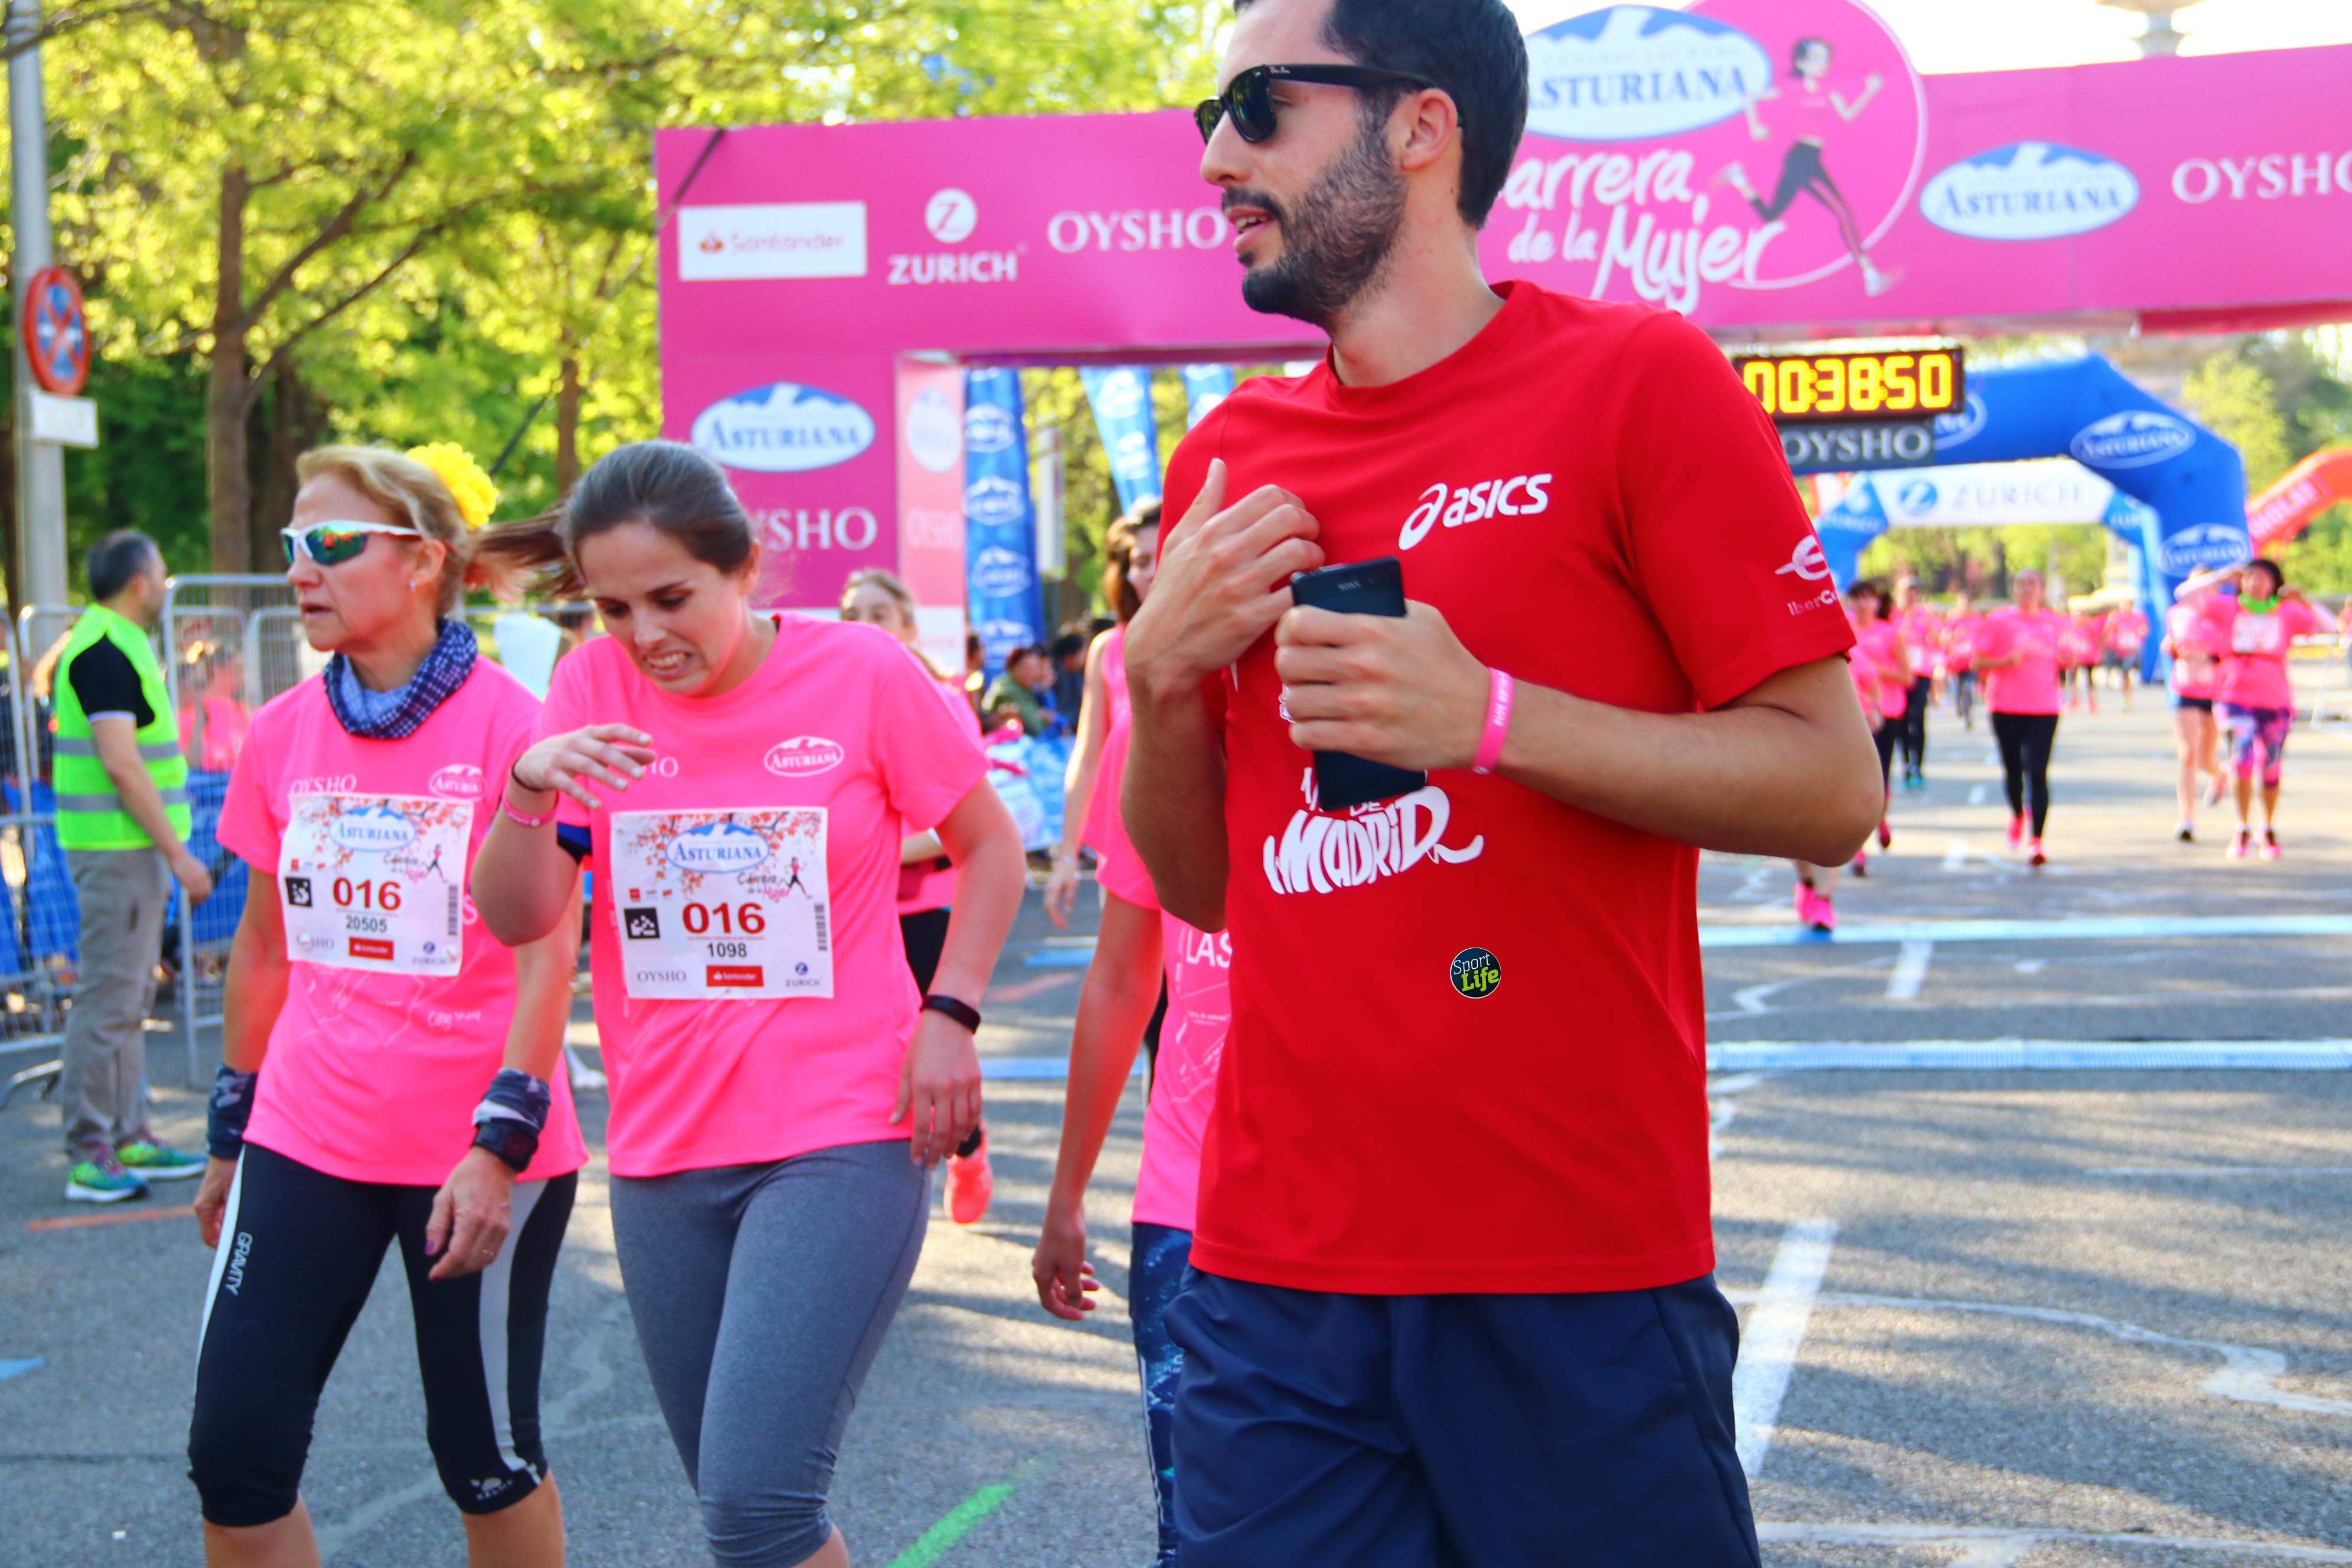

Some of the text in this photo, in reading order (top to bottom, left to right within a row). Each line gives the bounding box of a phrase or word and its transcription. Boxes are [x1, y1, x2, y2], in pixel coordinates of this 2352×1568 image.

[1528, 66, 1746, 110] STURIANA
[1503, 149, 1694, 210] arrera
[1937, 183, 2121, 218] ASTURIANA
[1048, 208, 1227, 253] OYSHO
[887, 252, 1018, 285] ZURICH
[1508, 192, 1785, 316] de la Mujer
[1743, 354, 1952, 414] 00:38:50
[711, 420, 862, 451] ASTURIANA
[1783, 426, 1931, 465] OYSHO
[1954, 484, 2081, 509] ZURICH
[771, 750, 838, 769] ASTURIANA
[290, 774, 356, 794] OYSHO
[337, 822, 409, 841] ASTURIANA
[674, 842, 762, 861] ASTURIANA
[333, 878, 401, 911] 016
[346, 915, 388, 933] 20505
[682, 903, 765, 934] 016
[707, 943, 747, 958] 1098
[636, 970, 687, 983] OYSHO
[785, 978, 821, 988] ZURICH
[224, 1231, 253, 1295] GRAVITY
